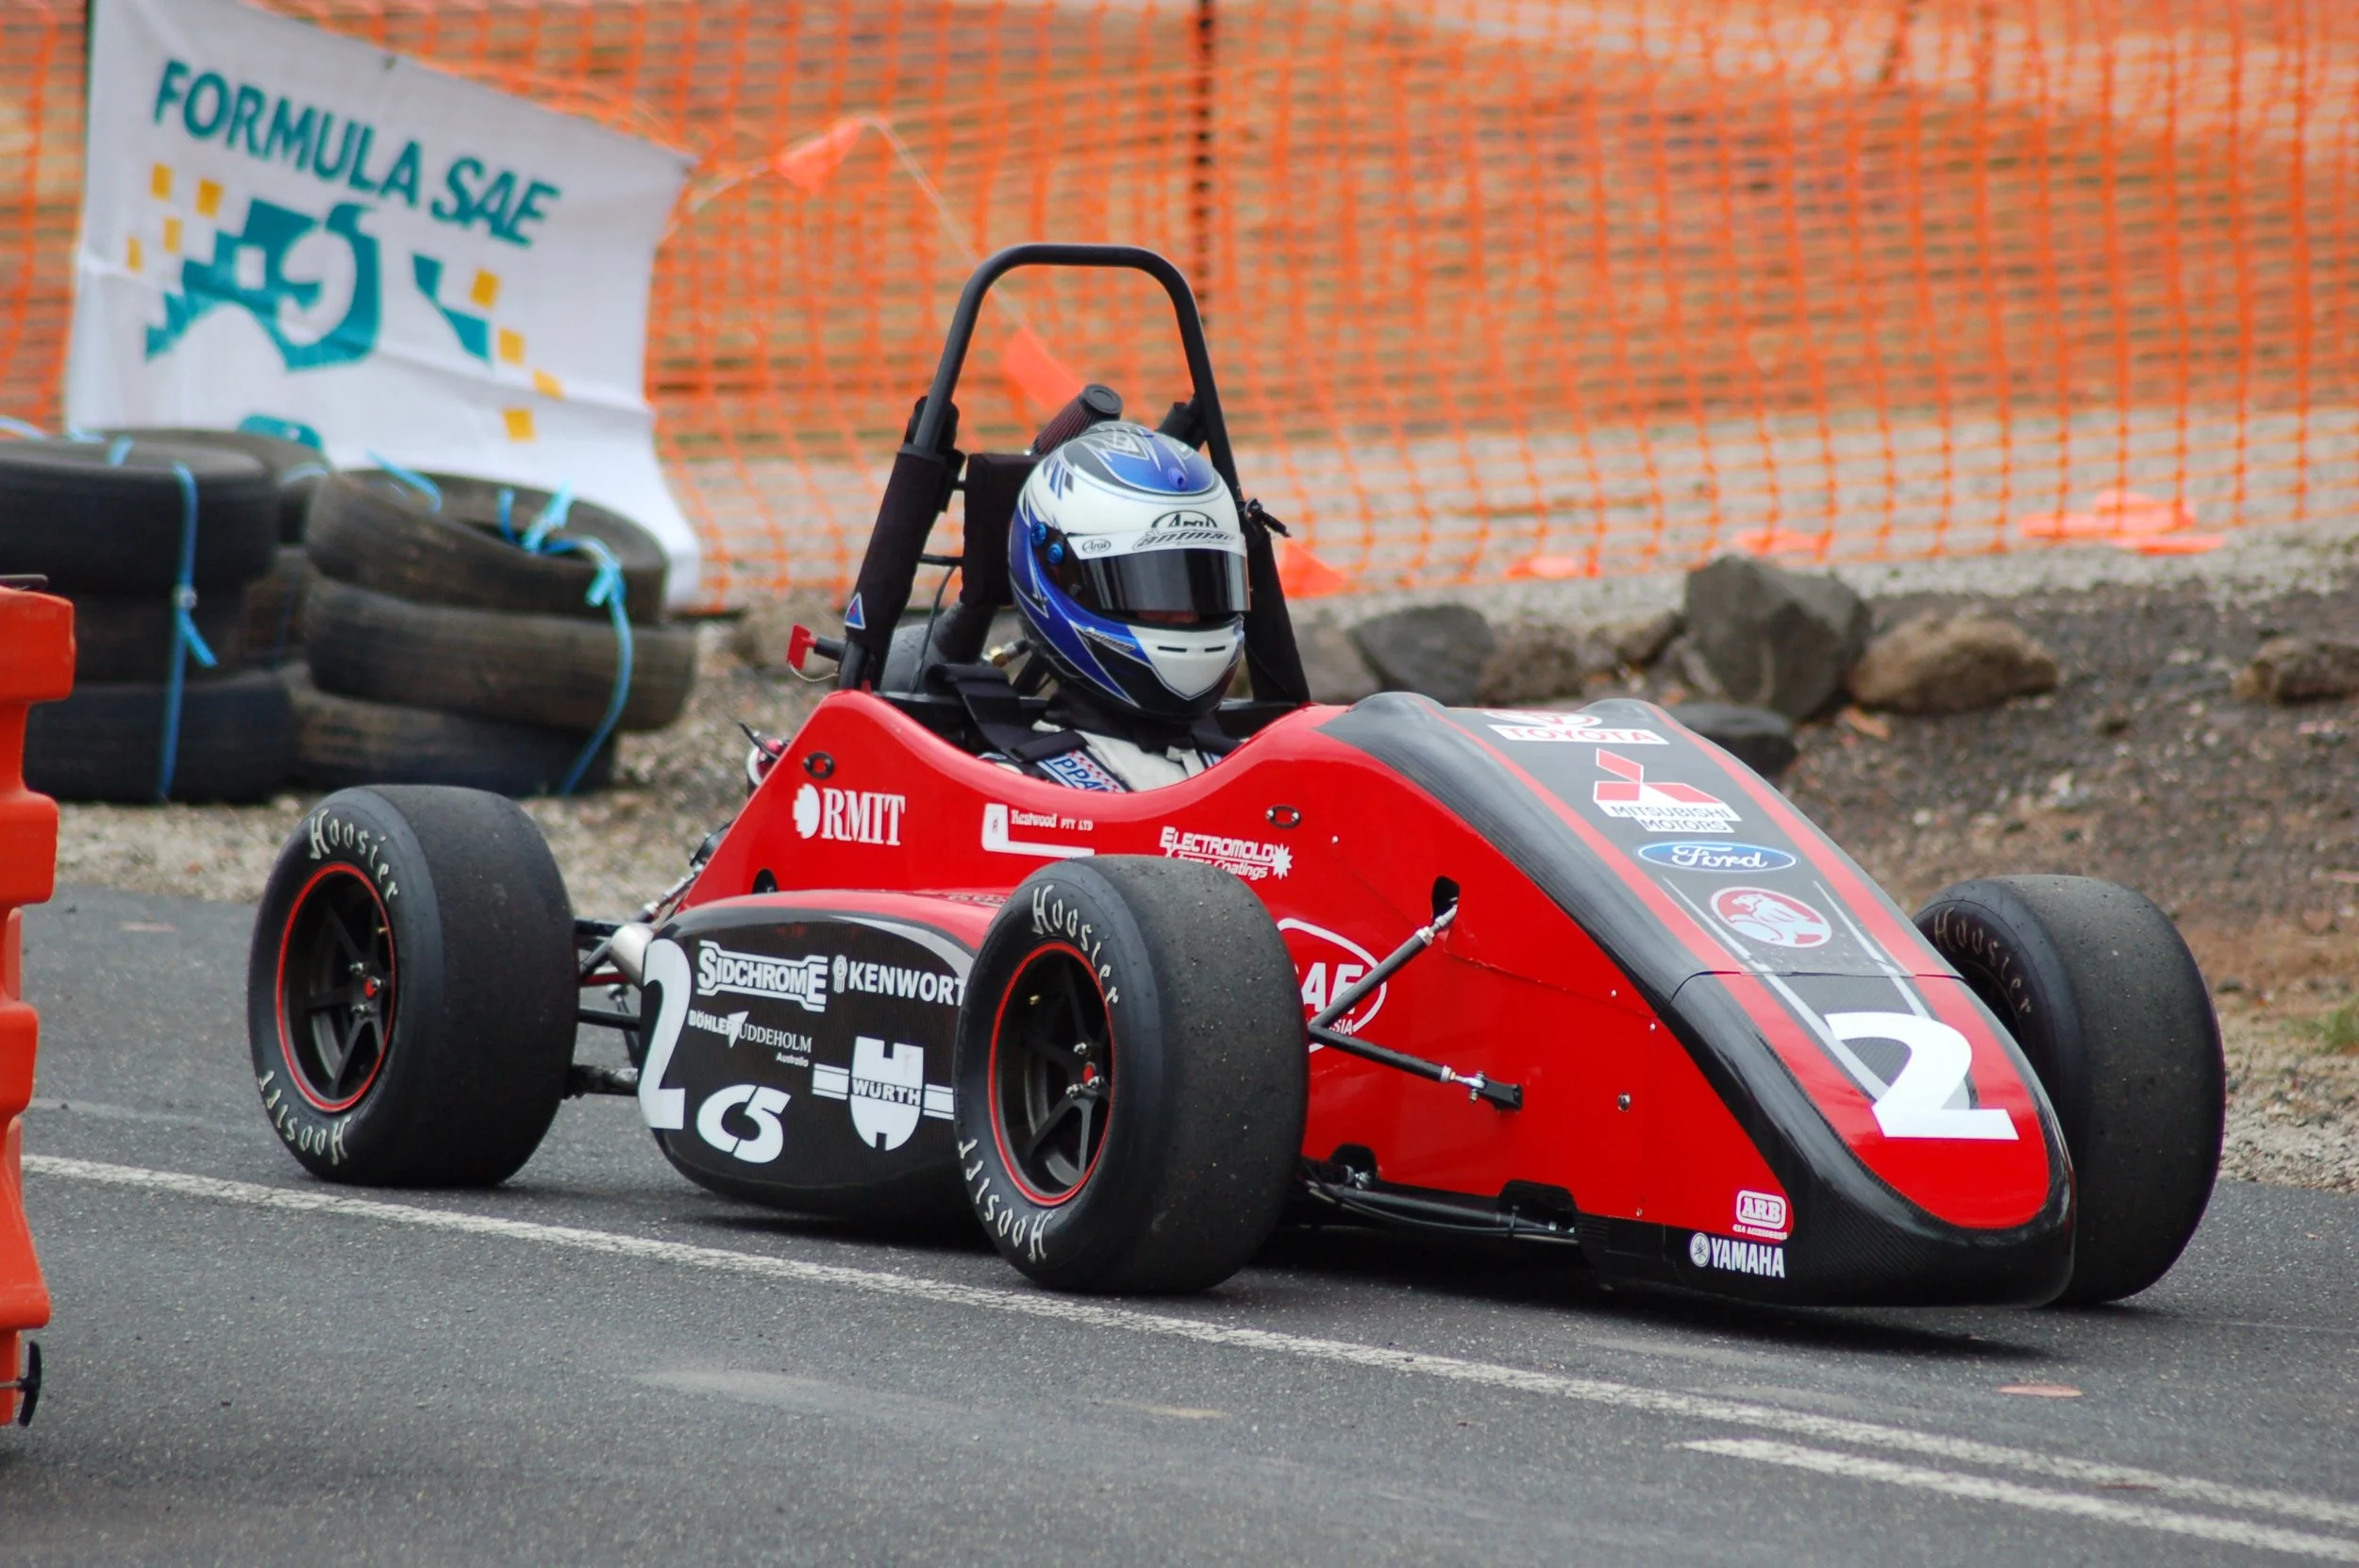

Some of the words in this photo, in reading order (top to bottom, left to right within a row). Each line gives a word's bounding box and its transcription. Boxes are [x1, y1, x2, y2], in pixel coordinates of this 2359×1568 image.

[154, 58, 421, 209] FORMULA
[429, 157, 561, 249] SAE
[1502, 727, 1659, 742] TOYOTA
[821, 787, 906, 846] RMIT
[1610, 805, 1731, 820] MITSUBISHI
[1643, 819, 1728, 832] MOTORS
[308, 807, 399, 902] Hoosier
[1671, 845, 1768, 868] Ford
[1031, 884, 1120, 1006] Hoosier
[1932, 906, 2033, 1014] Hoosier
[697, 947, 828, 1006] SIDCHROME
[848, 960, 966, 1007] KENWORT
[637, 938, 692, 1130] 2
[739, 1023, 812, 1054] UDDEHOLM
[1824, 1011, 2019, 1141] 2
[258, 1070, 353, 1166] Hoosier
[959, 1137, 1057, 1264] Hoosier
[1741, 1196, 1782, 1224] ARB
[1711, 1237, 1785, 1278] YAMAHA
